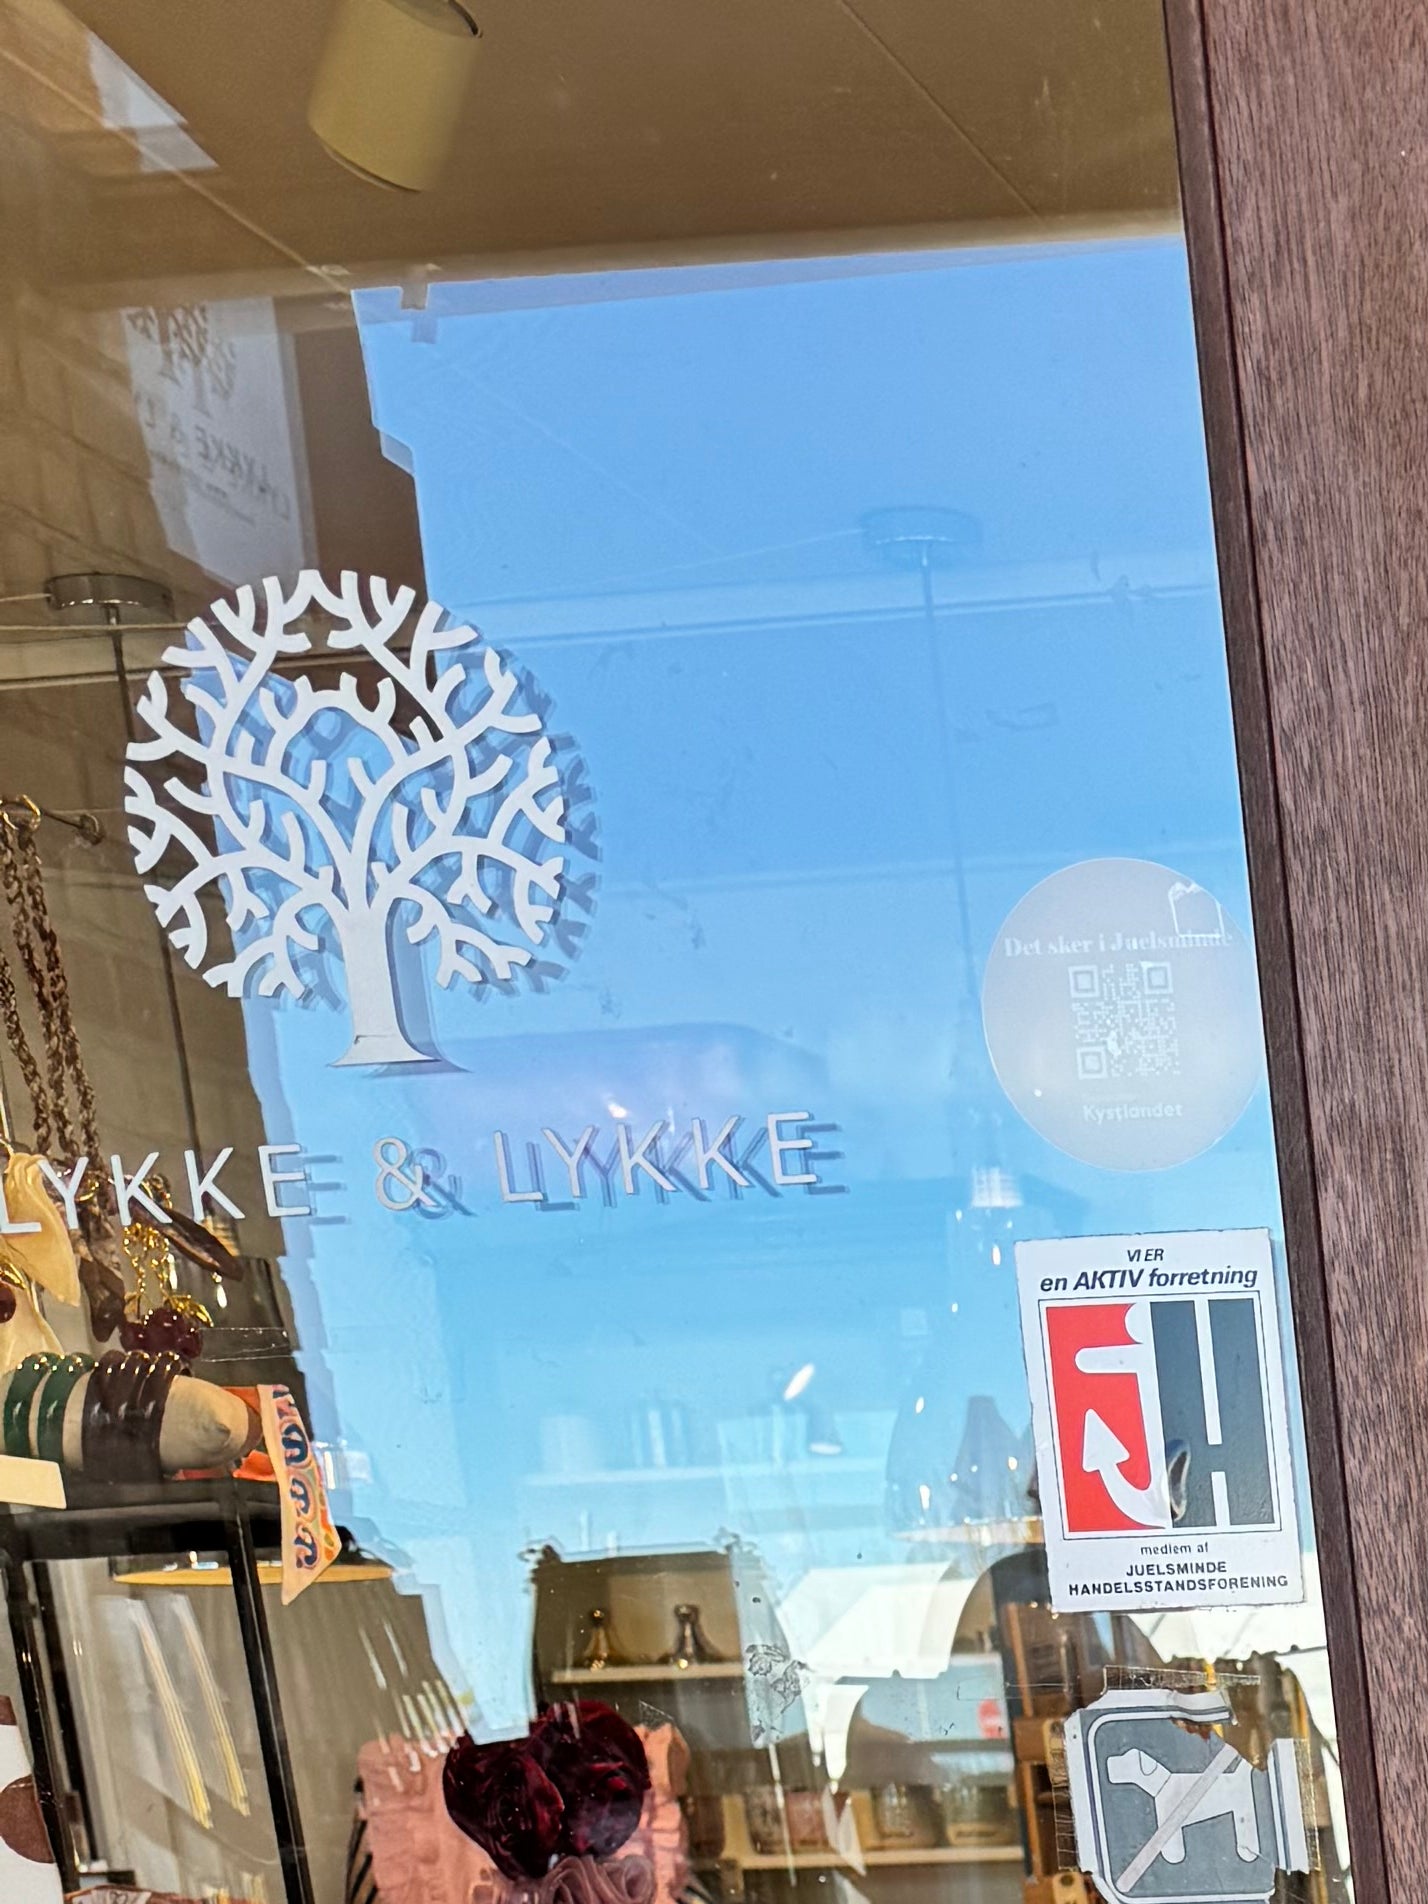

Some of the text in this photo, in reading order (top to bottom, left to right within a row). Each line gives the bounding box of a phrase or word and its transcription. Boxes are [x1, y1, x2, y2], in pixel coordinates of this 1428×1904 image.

[1004, 937, 1042, 957] Det
[1048, 934, 1092, 955] sker
[1099, 933, 1107, 953] i
[1083, 1102, 1183, 1125] Kystlandet
[371, 1135, 438, 1211] &
[493, 1111, 818, 1203] LYKKE
[1127, 1248, 1164, 1262] VI ER
[1040, 1265, 1259, 1292] en AKTIV forretning
[1140, 1541, 1209, 1556] medlem af
[1126, 1561, 1228, 1577] JUELSMINDE
[1069, 1575, 1289, 1597] HANDELSSTANDSFORENING
